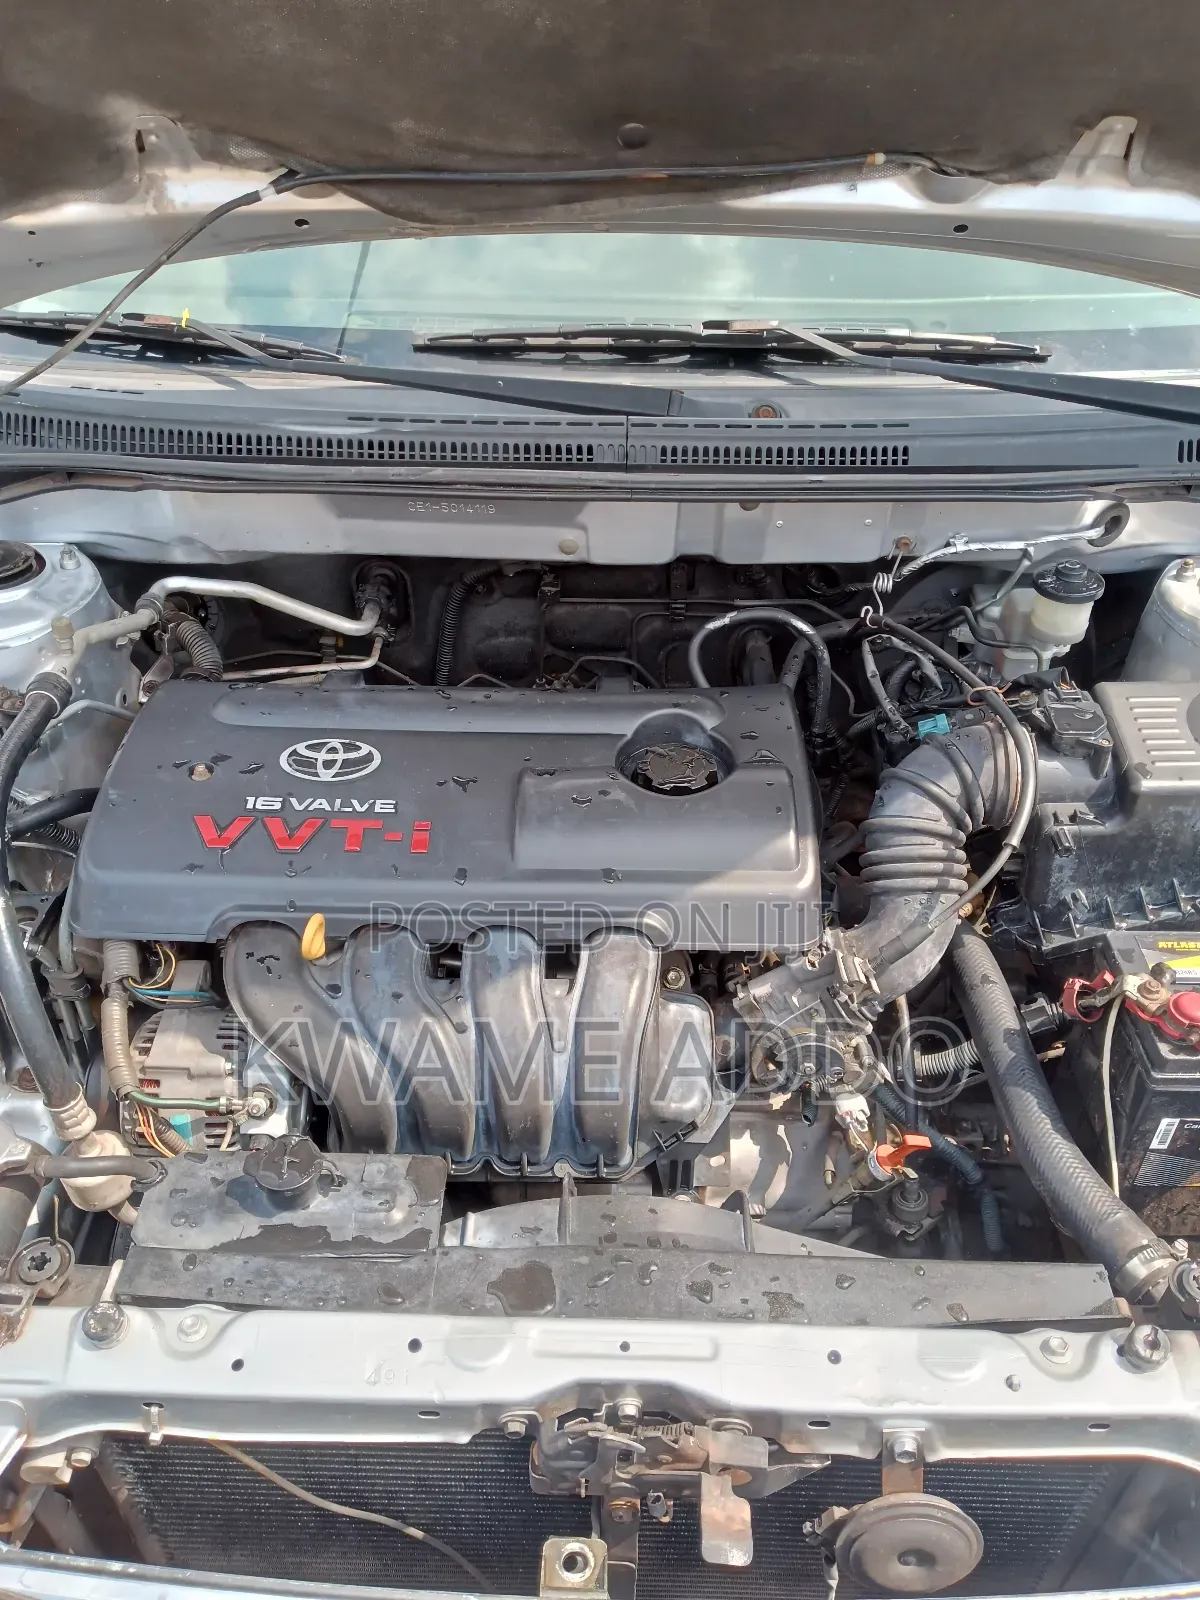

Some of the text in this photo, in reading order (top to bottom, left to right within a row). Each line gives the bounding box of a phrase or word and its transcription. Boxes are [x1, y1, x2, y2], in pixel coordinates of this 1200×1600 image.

[245, 796, 396, 813] 16 VALVE
[193, 815, 432, 854] VVT-i
